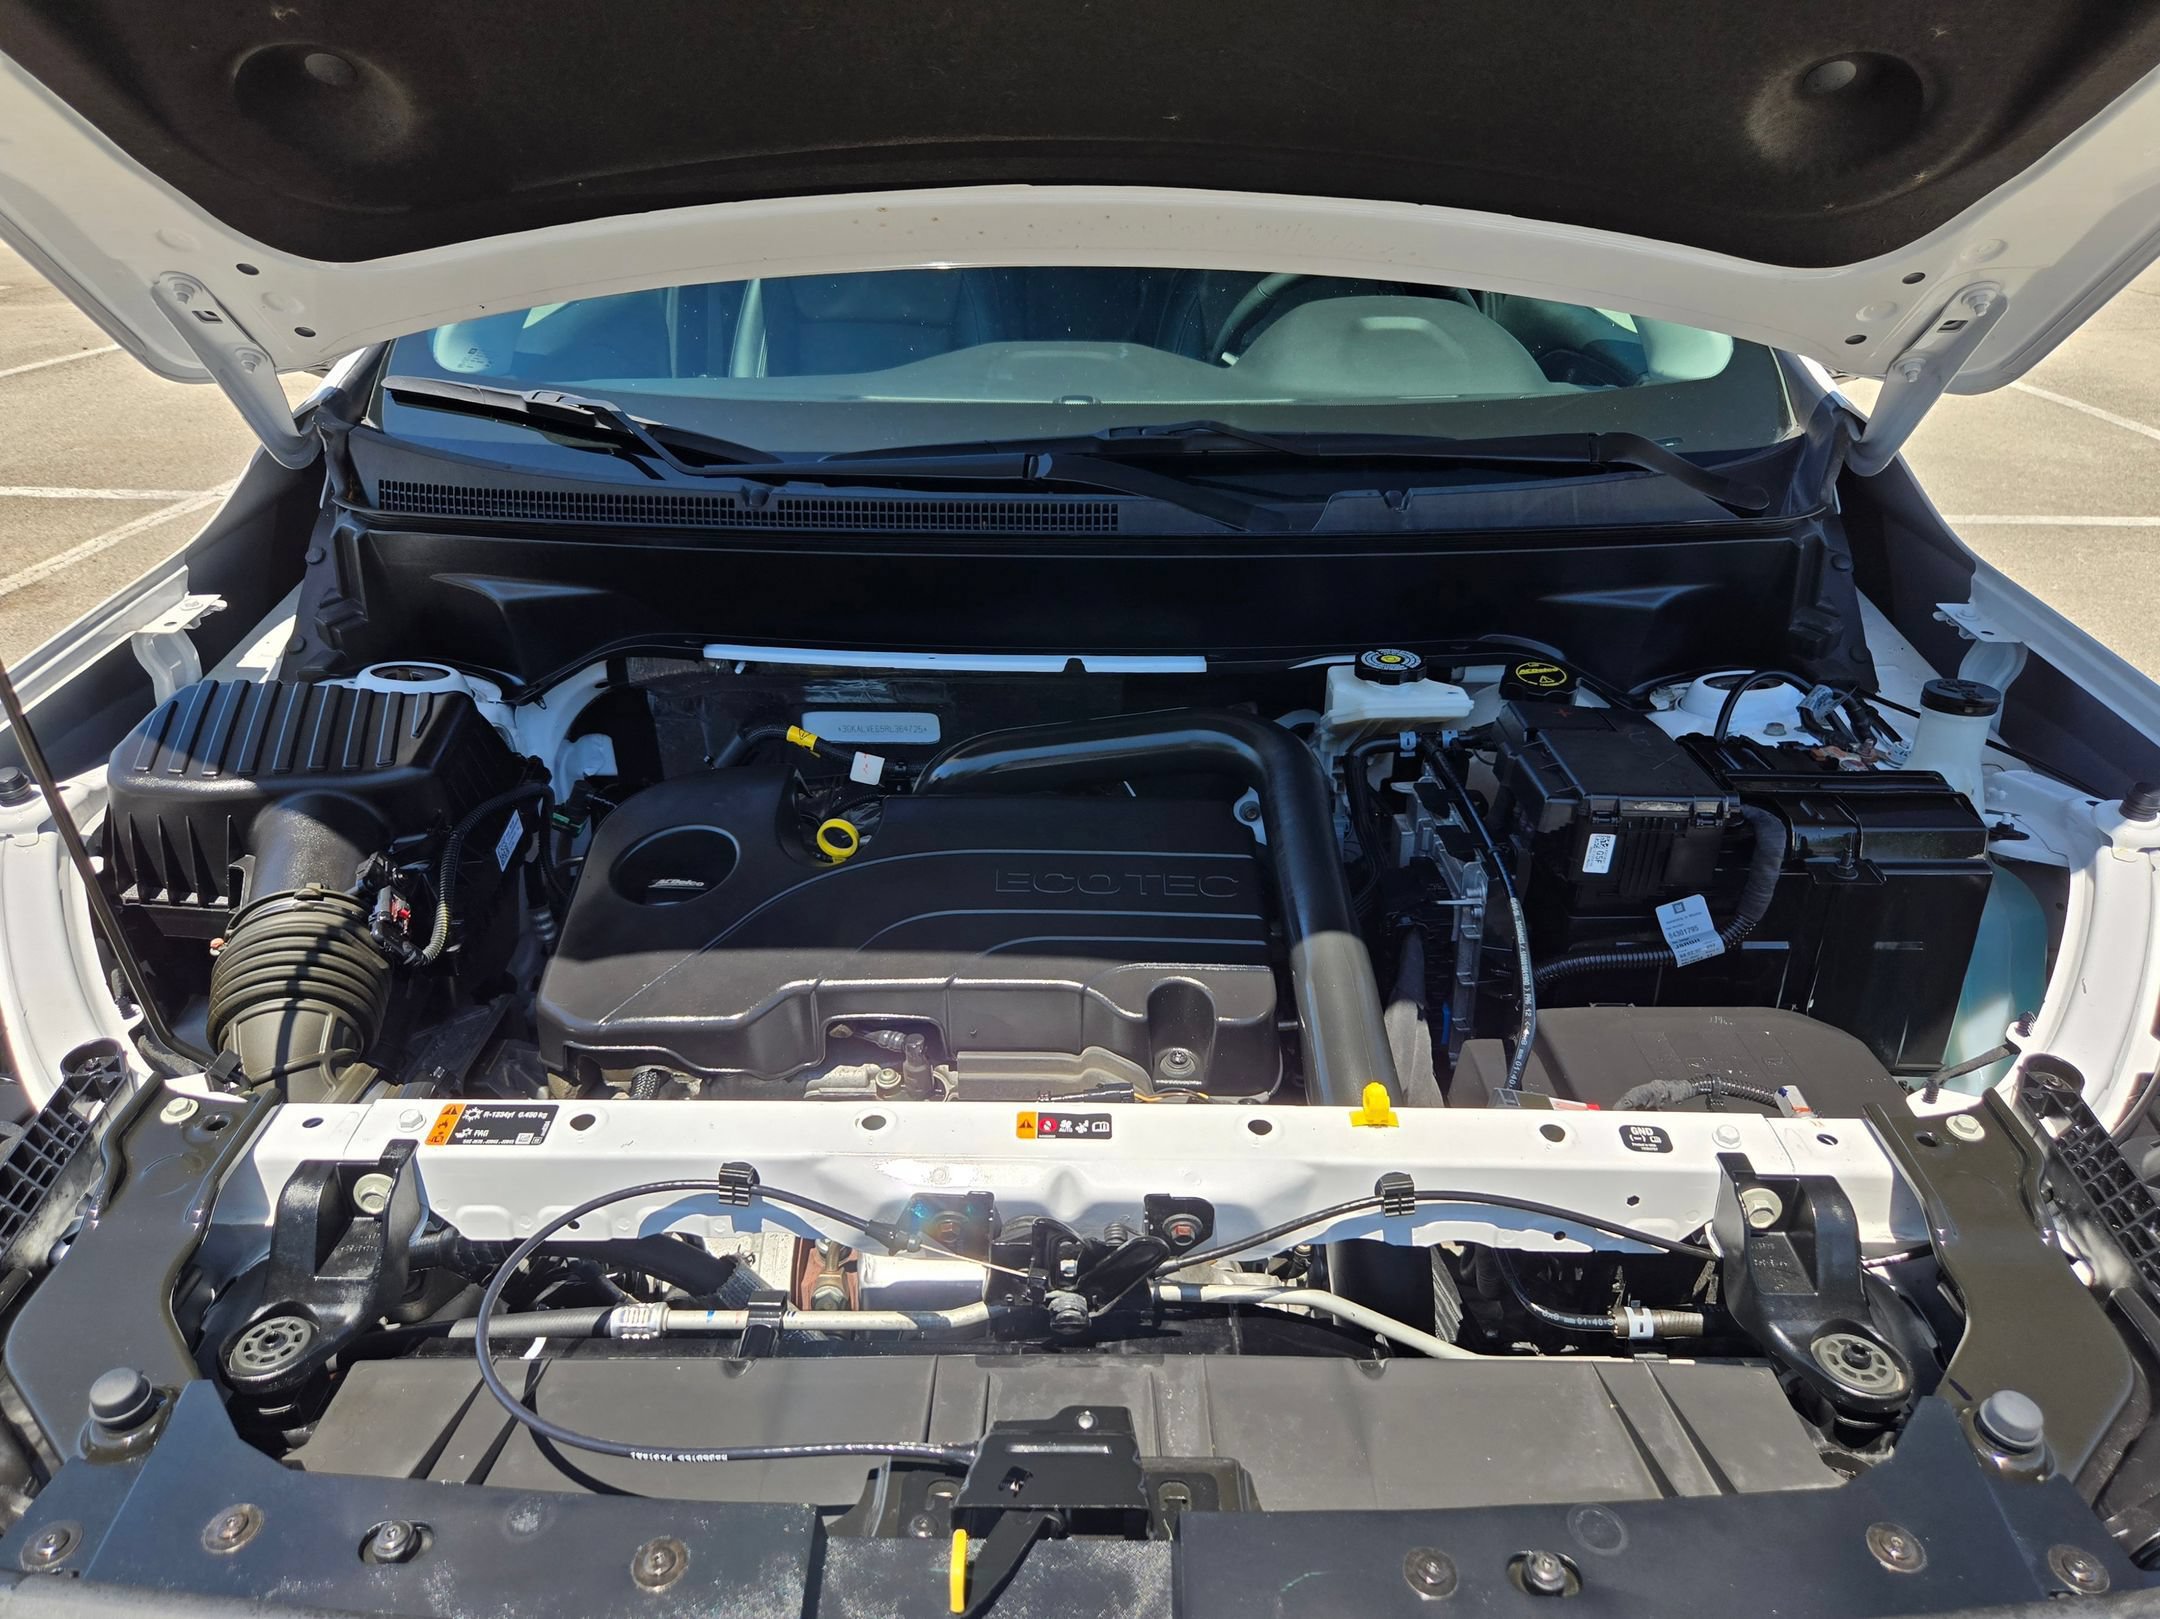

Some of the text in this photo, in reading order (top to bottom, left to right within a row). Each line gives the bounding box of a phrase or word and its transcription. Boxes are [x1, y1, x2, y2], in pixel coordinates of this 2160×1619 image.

[994, 868, 1240, 899] ECOTEC
[473, 1129, 490, 1137] PAG
[1630, 1126, 1654, 1137] GND
